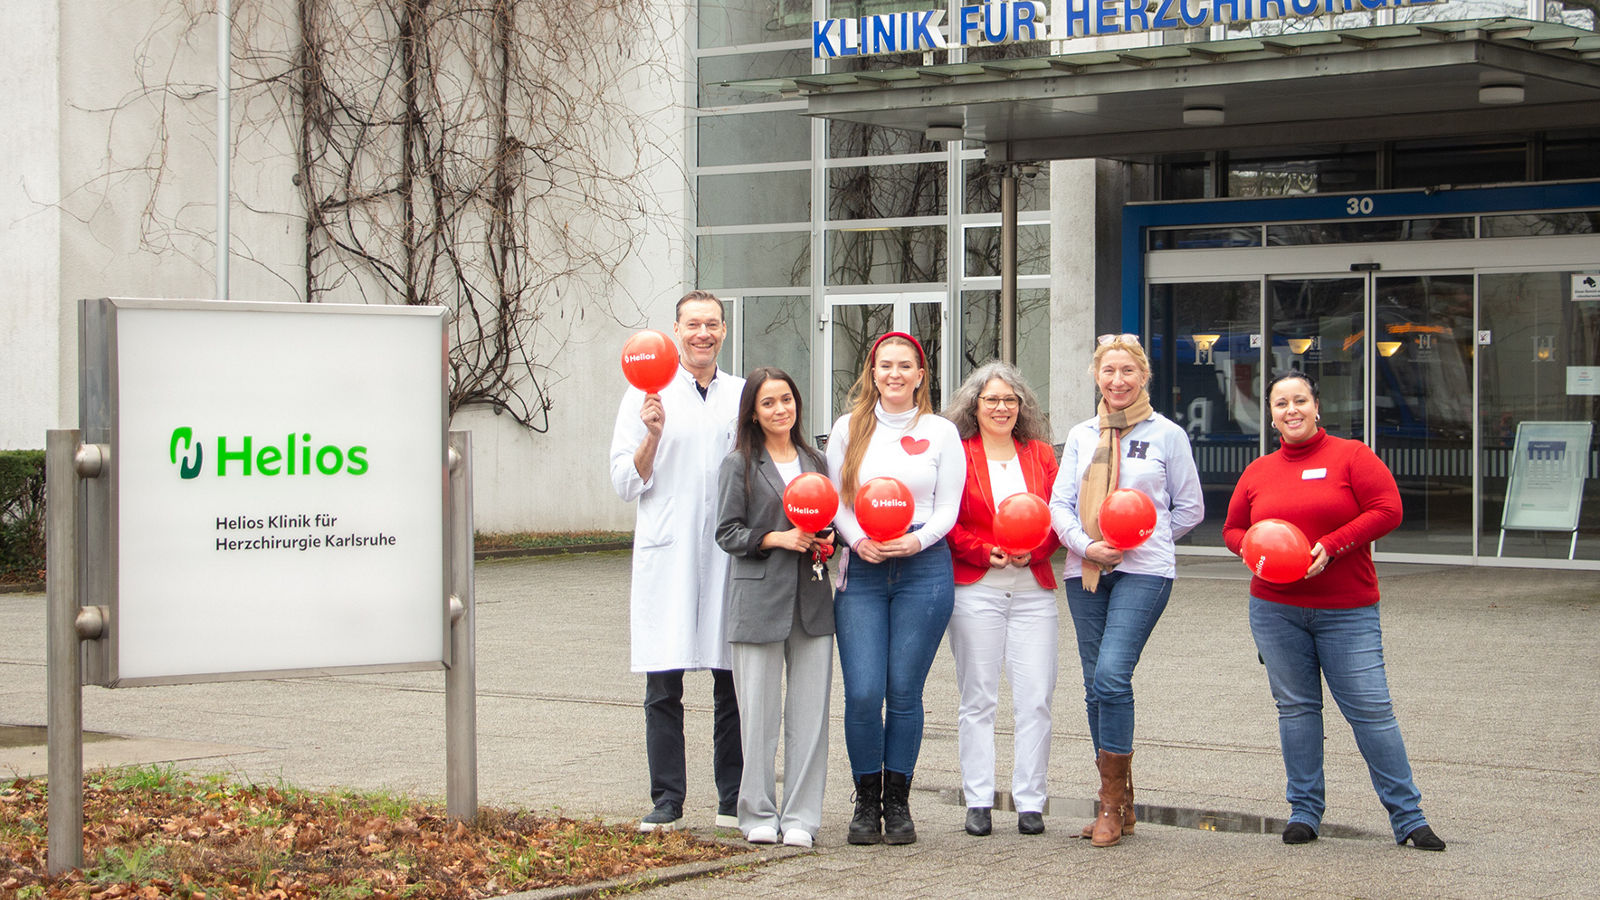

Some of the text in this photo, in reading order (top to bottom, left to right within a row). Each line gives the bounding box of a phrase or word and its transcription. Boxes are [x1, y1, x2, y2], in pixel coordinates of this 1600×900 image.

[813, 10, 938, 58] KLINIK
[960, 0, 1037, 45] FÜR
[1346, 197, 1374, 215] 30
[630, 353, 656, 362] Helios
[217, 432, 369, 476] Helios
[1127, 440, 1150, 460] H
[794, 506, 819, 514] Helios
[880, 499, 907, 507] Helios
[216, 514, 338, 530] Helios Klinik für
[216, 533, 397, 551] Herzchirurgie Karlsruhe
